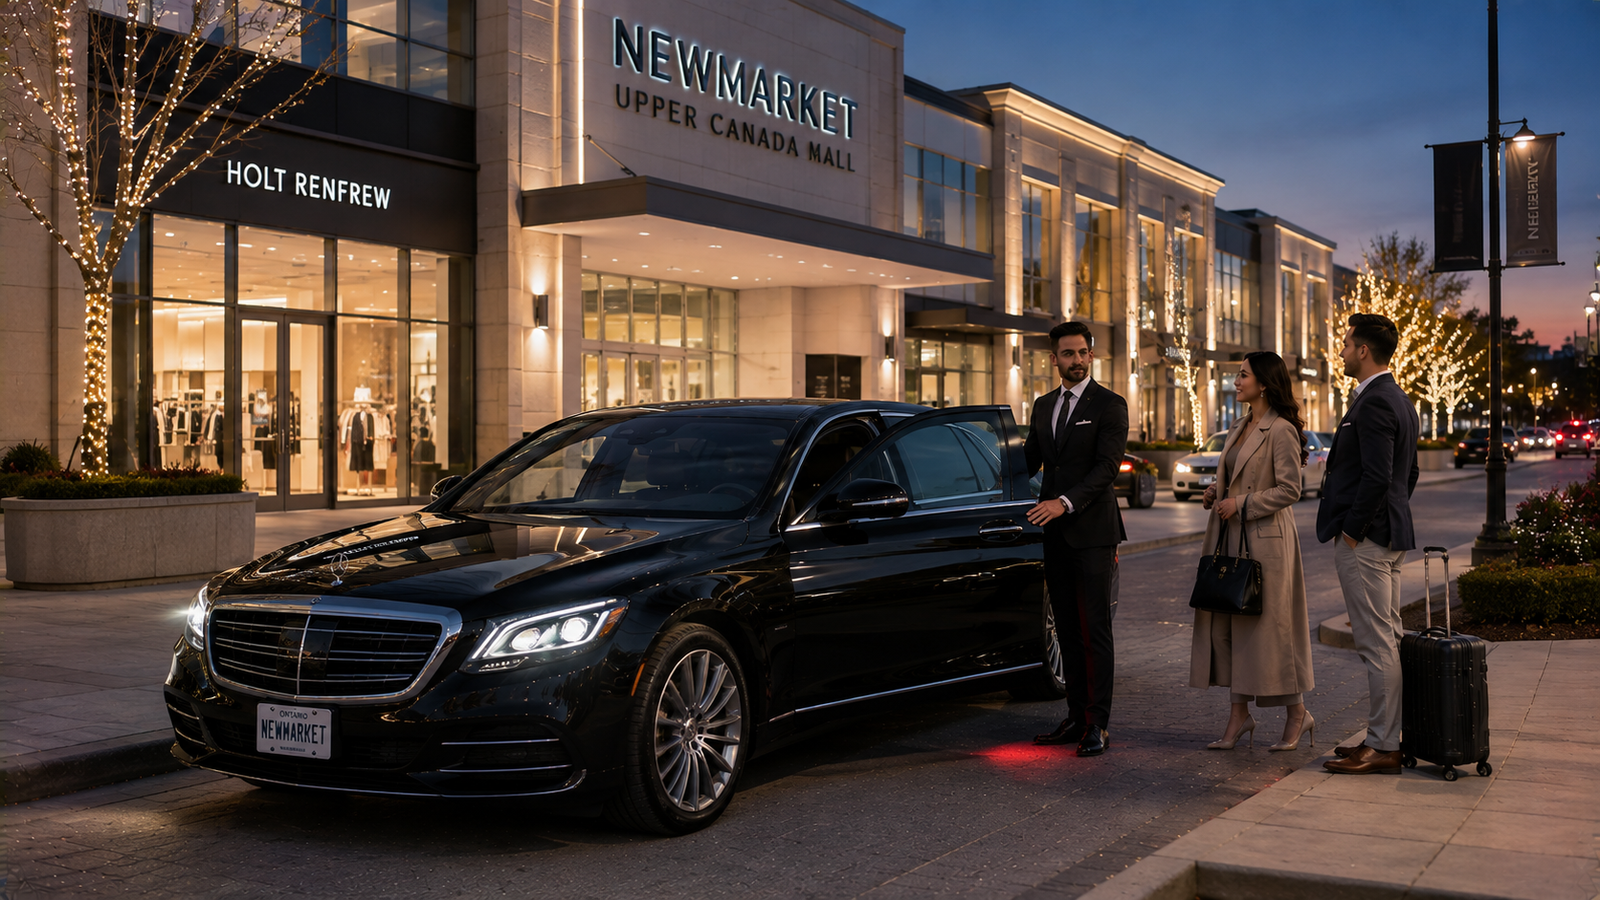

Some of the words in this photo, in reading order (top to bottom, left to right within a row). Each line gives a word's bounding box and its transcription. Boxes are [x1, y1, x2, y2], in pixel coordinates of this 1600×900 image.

[613, 17, 859, 140] NEWMARKET
[615, 83, 697, 129] UPPER
[710, 113, 799, 157] CANADA
[808, 141, 856, 173] MALL
[227, 159, 287, 193] HOLT
[295, 172, 391, 210] RENFREW
[261, 718, 327, 745] NEWMARKET
